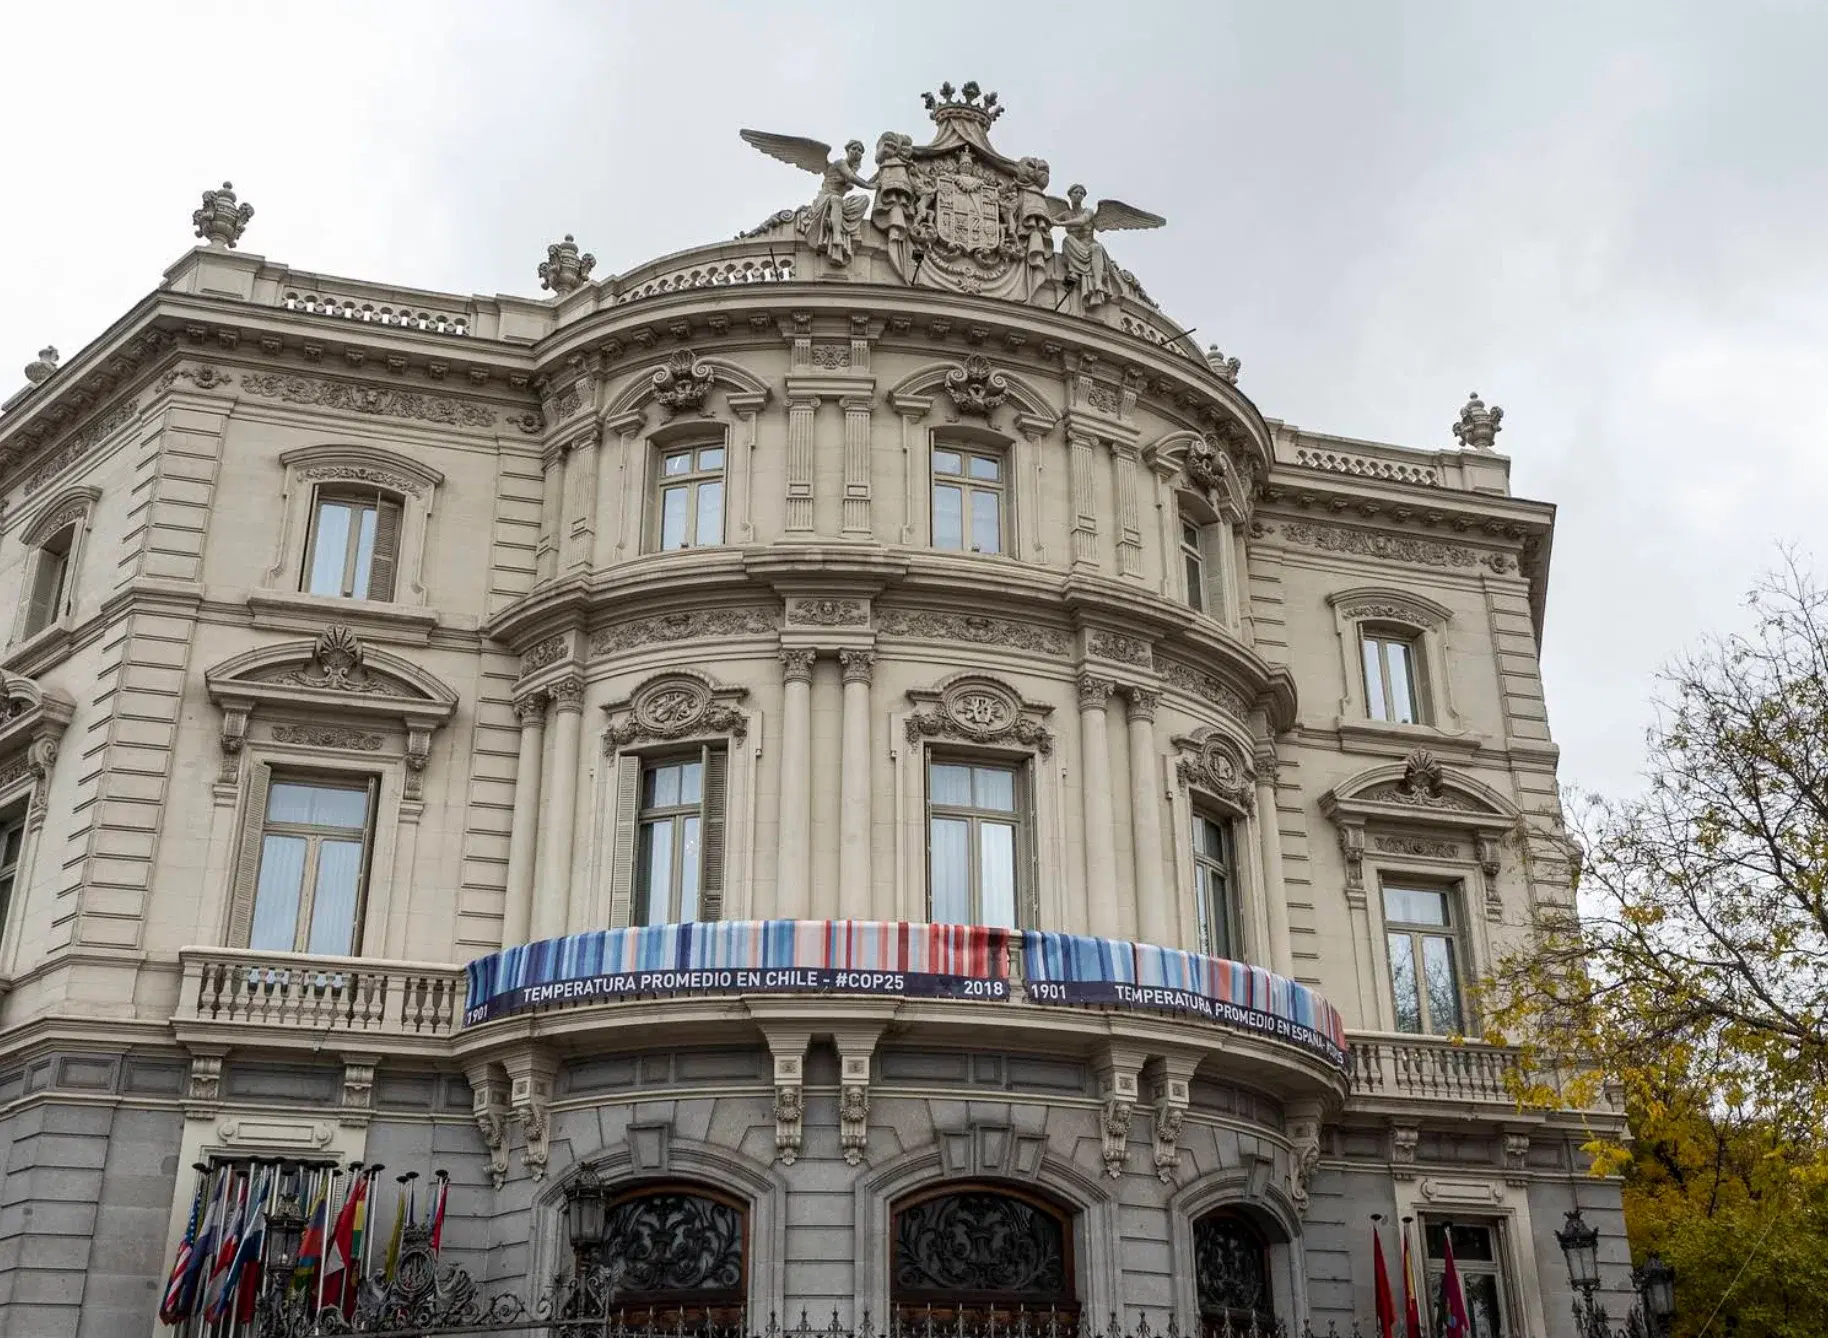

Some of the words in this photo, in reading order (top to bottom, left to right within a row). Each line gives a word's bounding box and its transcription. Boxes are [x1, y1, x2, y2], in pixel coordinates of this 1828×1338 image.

[523, 974, 636, 1002] TEMPERATURA
[640, 971, 732, 989] PROMEDIO
[736, 971, 760, 987] EN
[765, 971, 818, 987] CHILE
[835, 972, 904, 990] #COP25
[963, 980, 1003, 996] 2018
[1031, 983, 1067, 1000] 1901
[466, 1003, 488, 1025] 1901
[1114, 985, 1212, 1014] TEMPERATURA
[1215, 1002, 1275, 1031] PROMEDIO
[1277, 1019, 1290, 1036] EN
